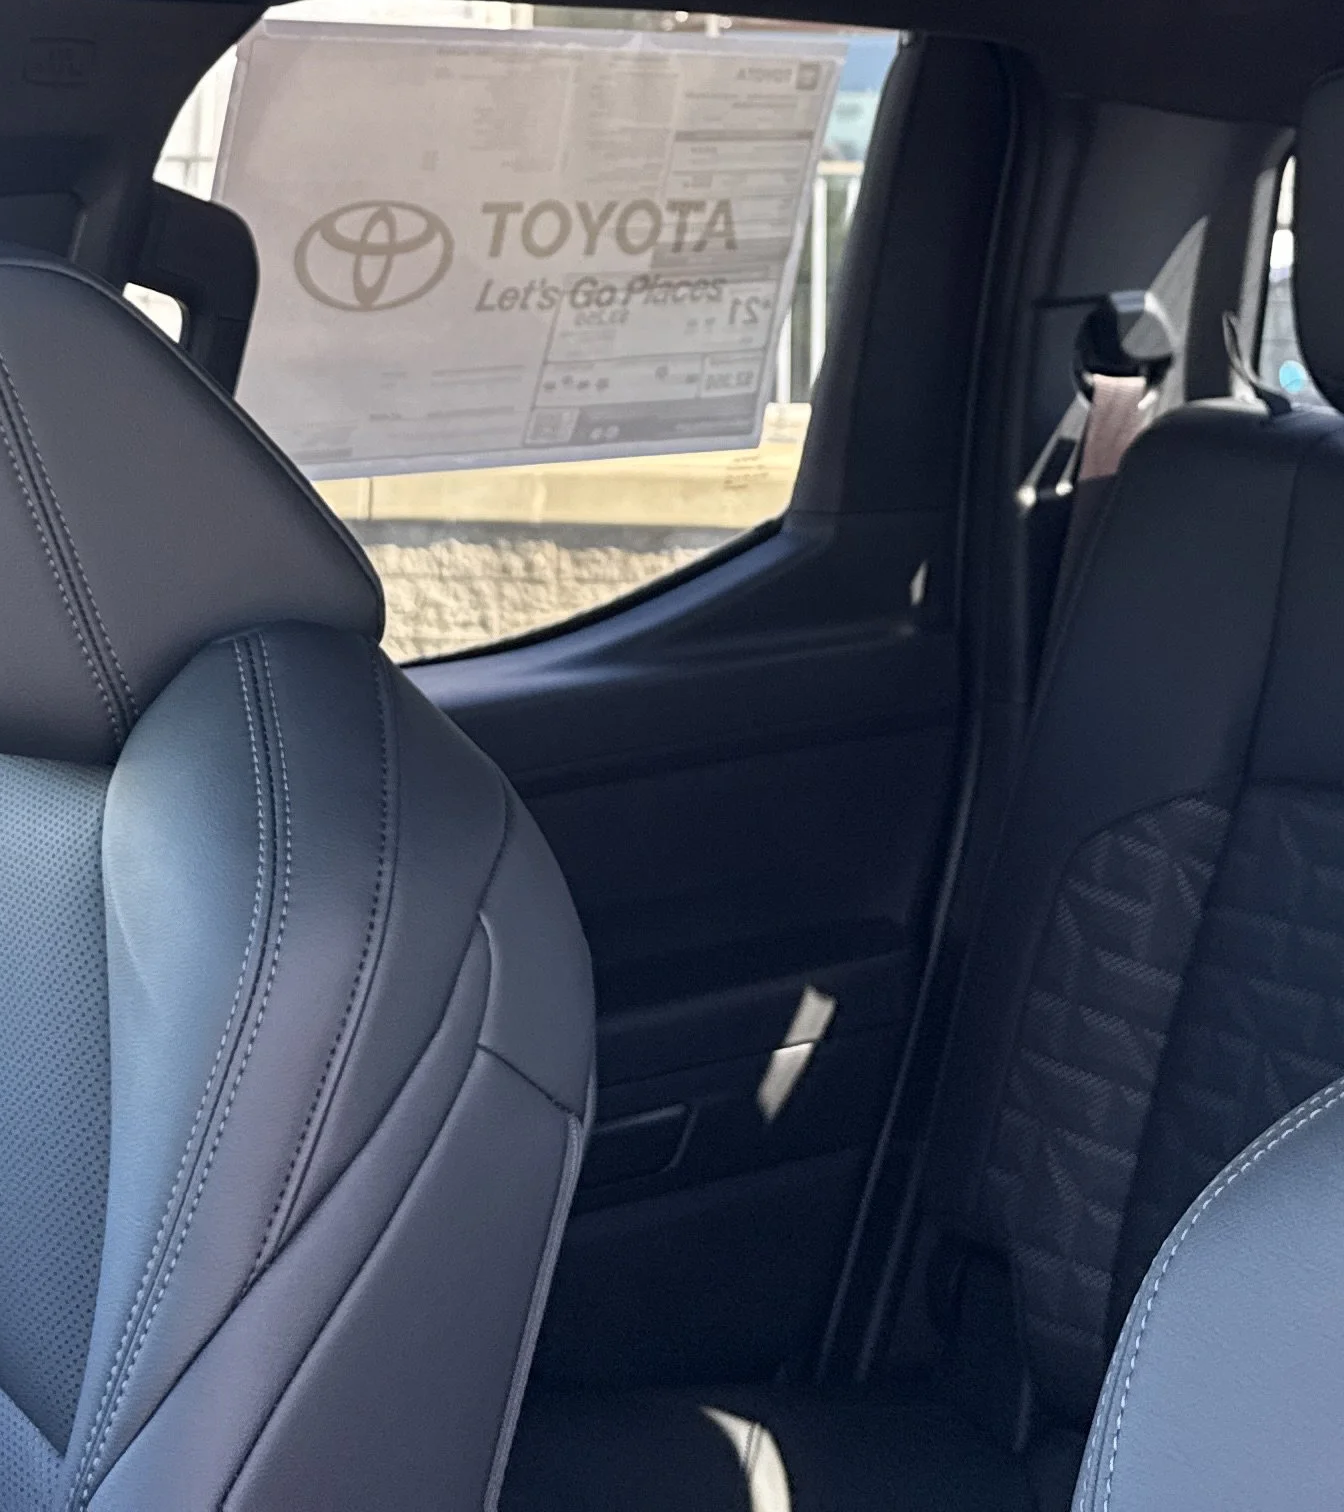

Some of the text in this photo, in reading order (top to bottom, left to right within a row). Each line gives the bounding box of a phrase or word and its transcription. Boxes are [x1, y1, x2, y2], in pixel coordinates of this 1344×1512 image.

[481, 198, 738, 259] TOYOTA
[475, 273, 726, 312] Let's Go Places
